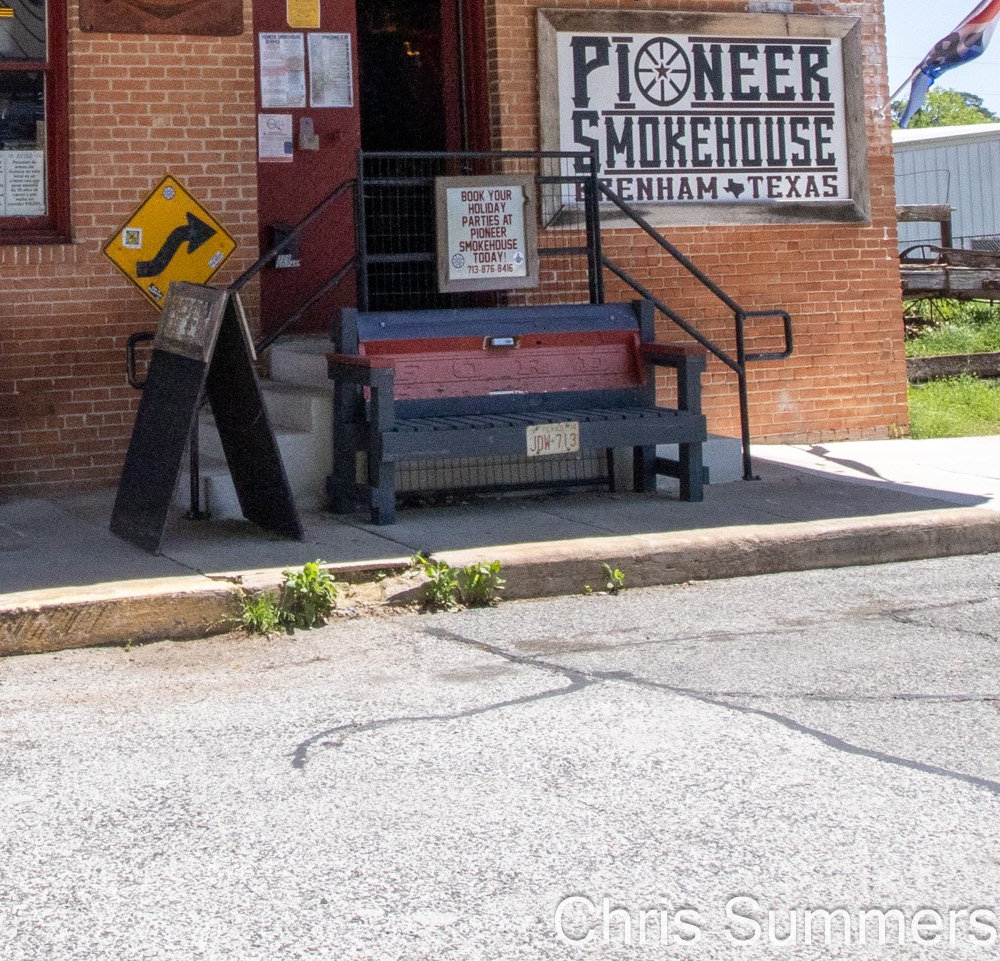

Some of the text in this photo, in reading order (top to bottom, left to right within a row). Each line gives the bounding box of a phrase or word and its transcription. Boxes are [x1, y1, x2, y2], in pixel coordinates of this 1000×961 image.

[570, 36, 831, 108] PIONEER
[571, 110, 836, 173] SMOKEHOUSE
[747, 174, 839, 198] TEXAS
[461, 189, 512, 202] BOOK YOUR
[468, 202, 506, 214] HOLIDAY
[461, 214, 513, 227] PARTIES AT
[470, 227, 507, 239] PIONEER
[459, 239, 518, 252] SMOKEHOUSE
[473, 252, 507, 264] TODAY!
